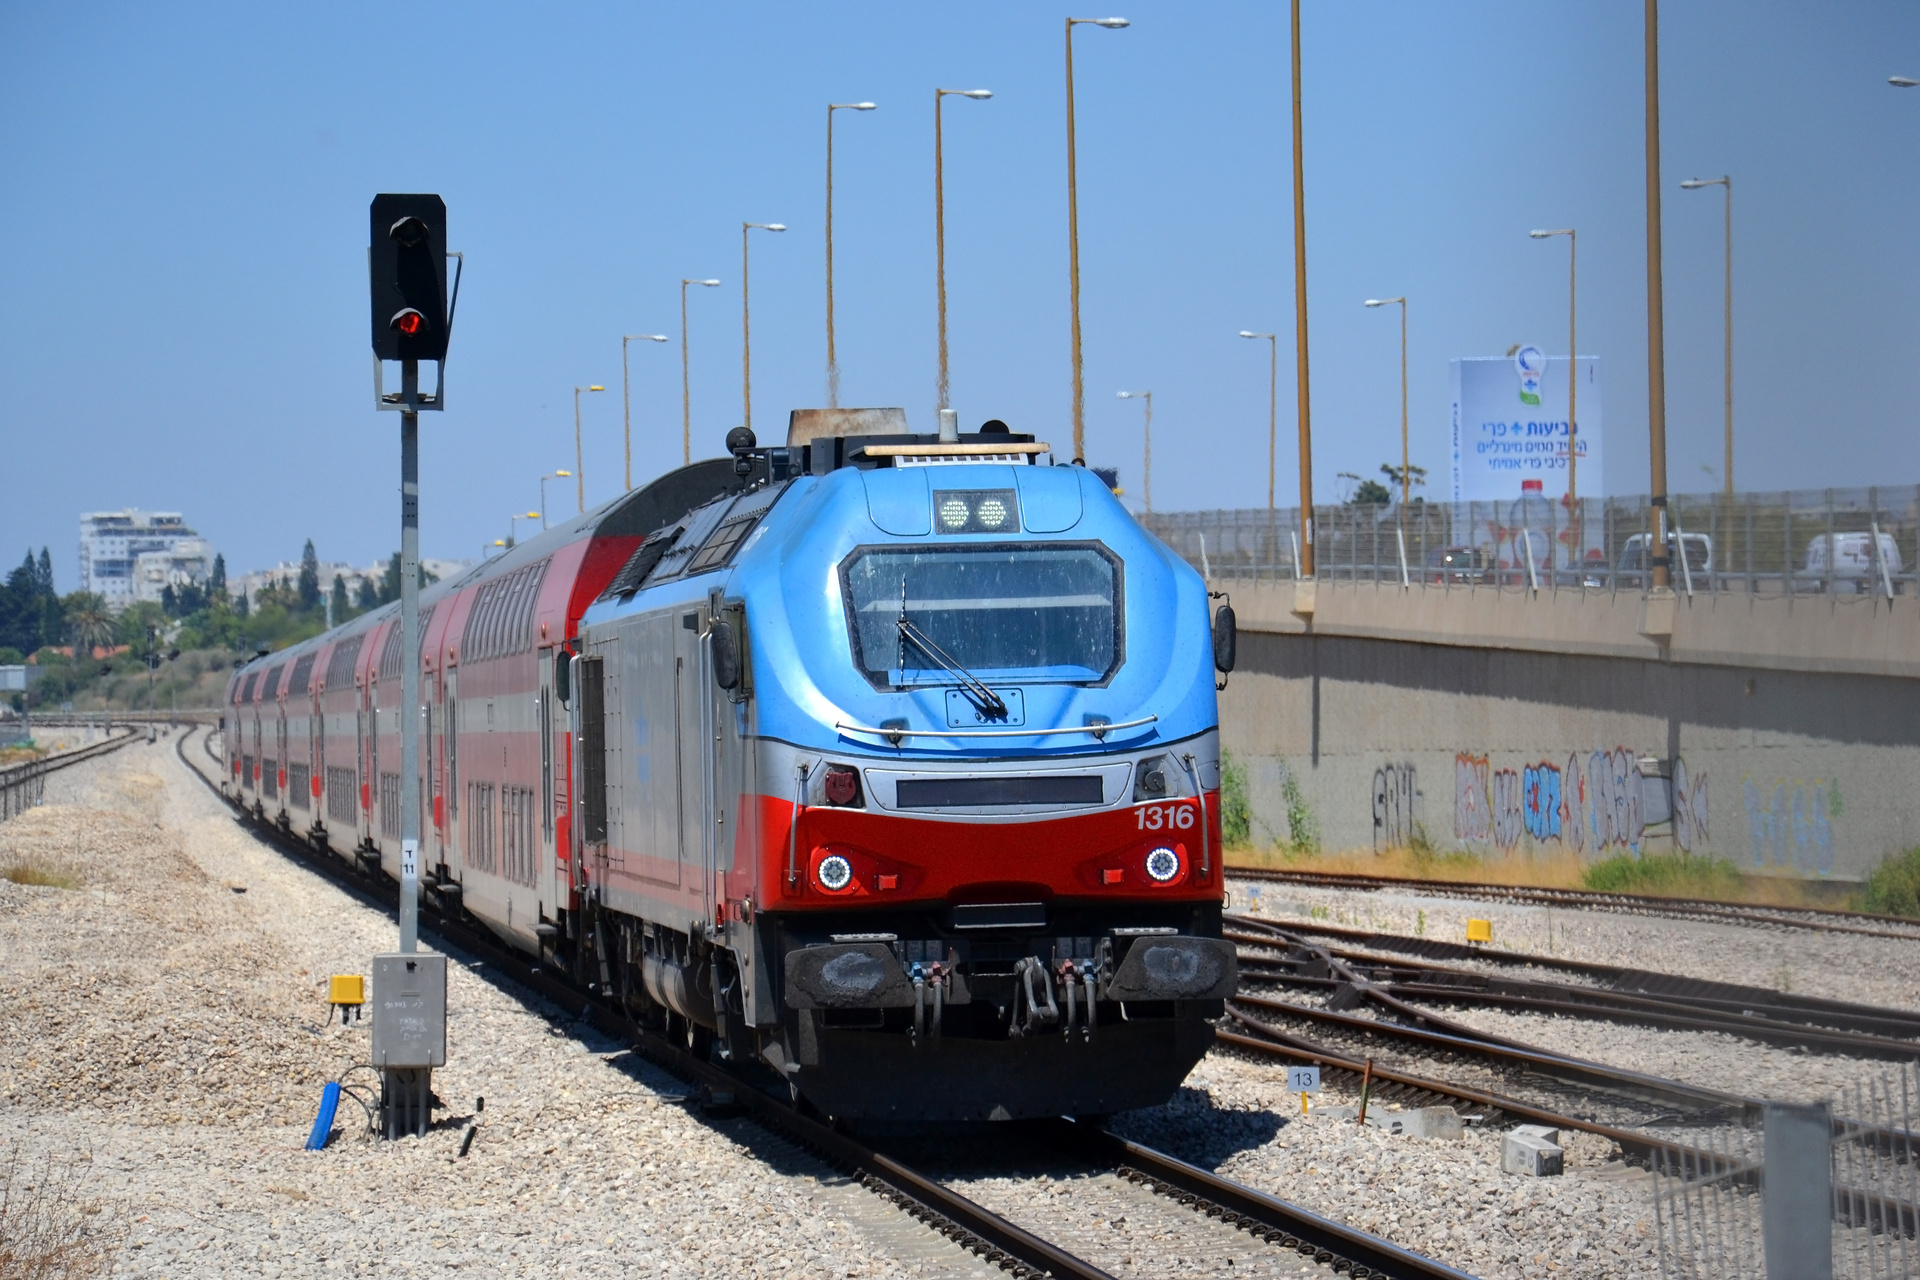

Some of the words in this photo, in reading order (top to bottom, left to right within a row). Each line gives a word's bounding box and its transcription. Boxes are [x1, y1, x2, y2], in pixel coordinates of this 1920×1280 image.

[1482, 422, 1507, 436] פרי
[1556, 439, 1587, 452] הייד
[1524, 457, 1542, 469] פרי
[1545, 457, 1574, 469] כיבי
[1134, 805, 1194, 830] 1316
[403, 863, 414, 874] 11
[1295, 1073, 1313, 1087] 13
